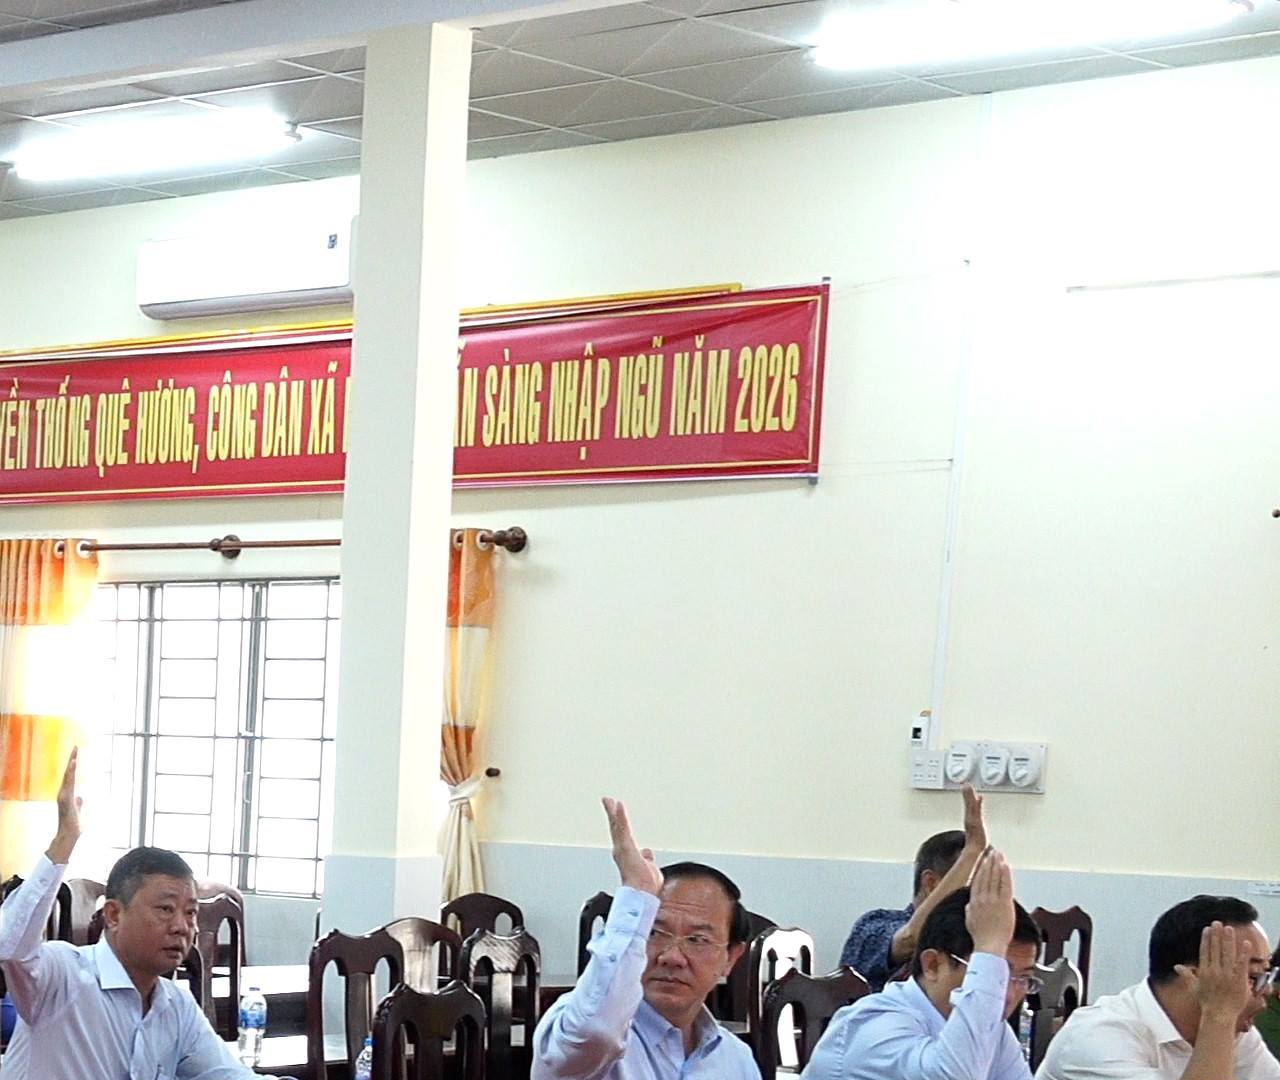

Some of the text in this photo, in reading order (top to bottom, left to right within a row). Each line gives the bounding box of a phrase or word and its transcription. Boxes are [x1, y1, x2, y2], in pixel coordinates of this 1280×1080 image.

[36, 375, 91, 468] THỐNG
[95, 378, 132, 478] QUÊ
[135, 378, 200, 473] HƯƠNG,
[207, 370, 258, 462] CÔNG
[261, 366, 304, 458] DÂN
[307, 361, 338, 455] XÃ
[483, 348, 542, 447] SÀNG
[548, 342, 611, 460] NHẬP
[614, 335, 664, 440] NGŨ
[669, 334, 730, 436] NĂM
[734, 342, 800, 433] 2026
